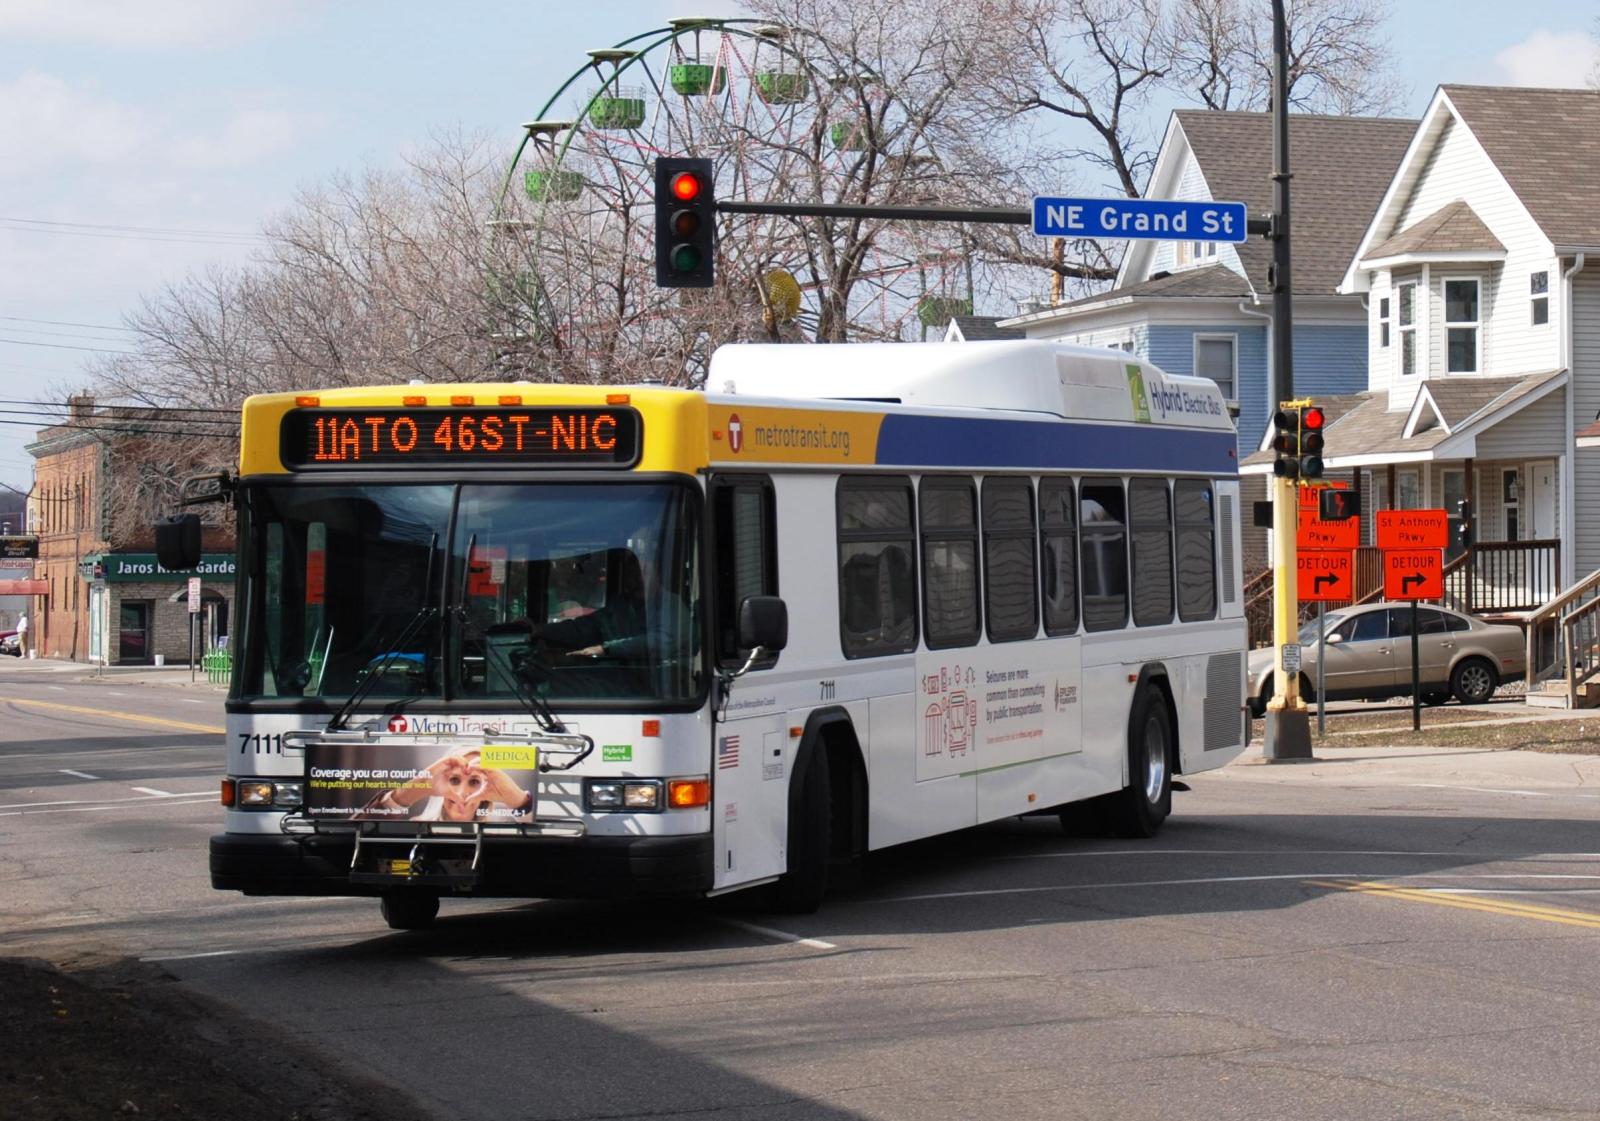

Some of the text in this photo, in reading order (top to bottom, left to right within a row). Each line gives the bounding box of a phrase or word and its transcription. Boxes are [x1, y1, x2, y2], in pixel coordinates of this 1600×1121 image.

[1047, 205, 1233, 234] NE Grand St
[1149, 382, 1183, 419] Hybrid
[1182, 392, 1208, 414] Electric
[1208, 395, 1221, 415] Bus
[434, 415, 616, 451] 46ST-NIC
[755, 422, 850, 456] metrotransit.org
[1382, 517, 1442, 528] St Anthony
[1309, 532, 1336, 543] Pkwy
[1399, 533, 1425, 544] Pkwy
[117, 561, 153, 574] Jaros
[196, 561, 236, 574] Garde
[1297, 558, 1347, 570] DETOUR
[1392, 557, 1434, 568] DETOUR
[819, 680, 835, 700] 7111
[986, 684, 1045, 702] common than commuting
[238, 734, 281, 754] 7111
[485, 751, 530, 761] MEDICA
[310, 767, 351, 780] Coverage
[352, 769, 370, 780] you
[371, 769, 388, 778] can
[390, 768, 418, 778] count
[328, 780, 352, 790] putting
[365, 780, 387, 788] hearts
[388, 780, 401, 788] into
